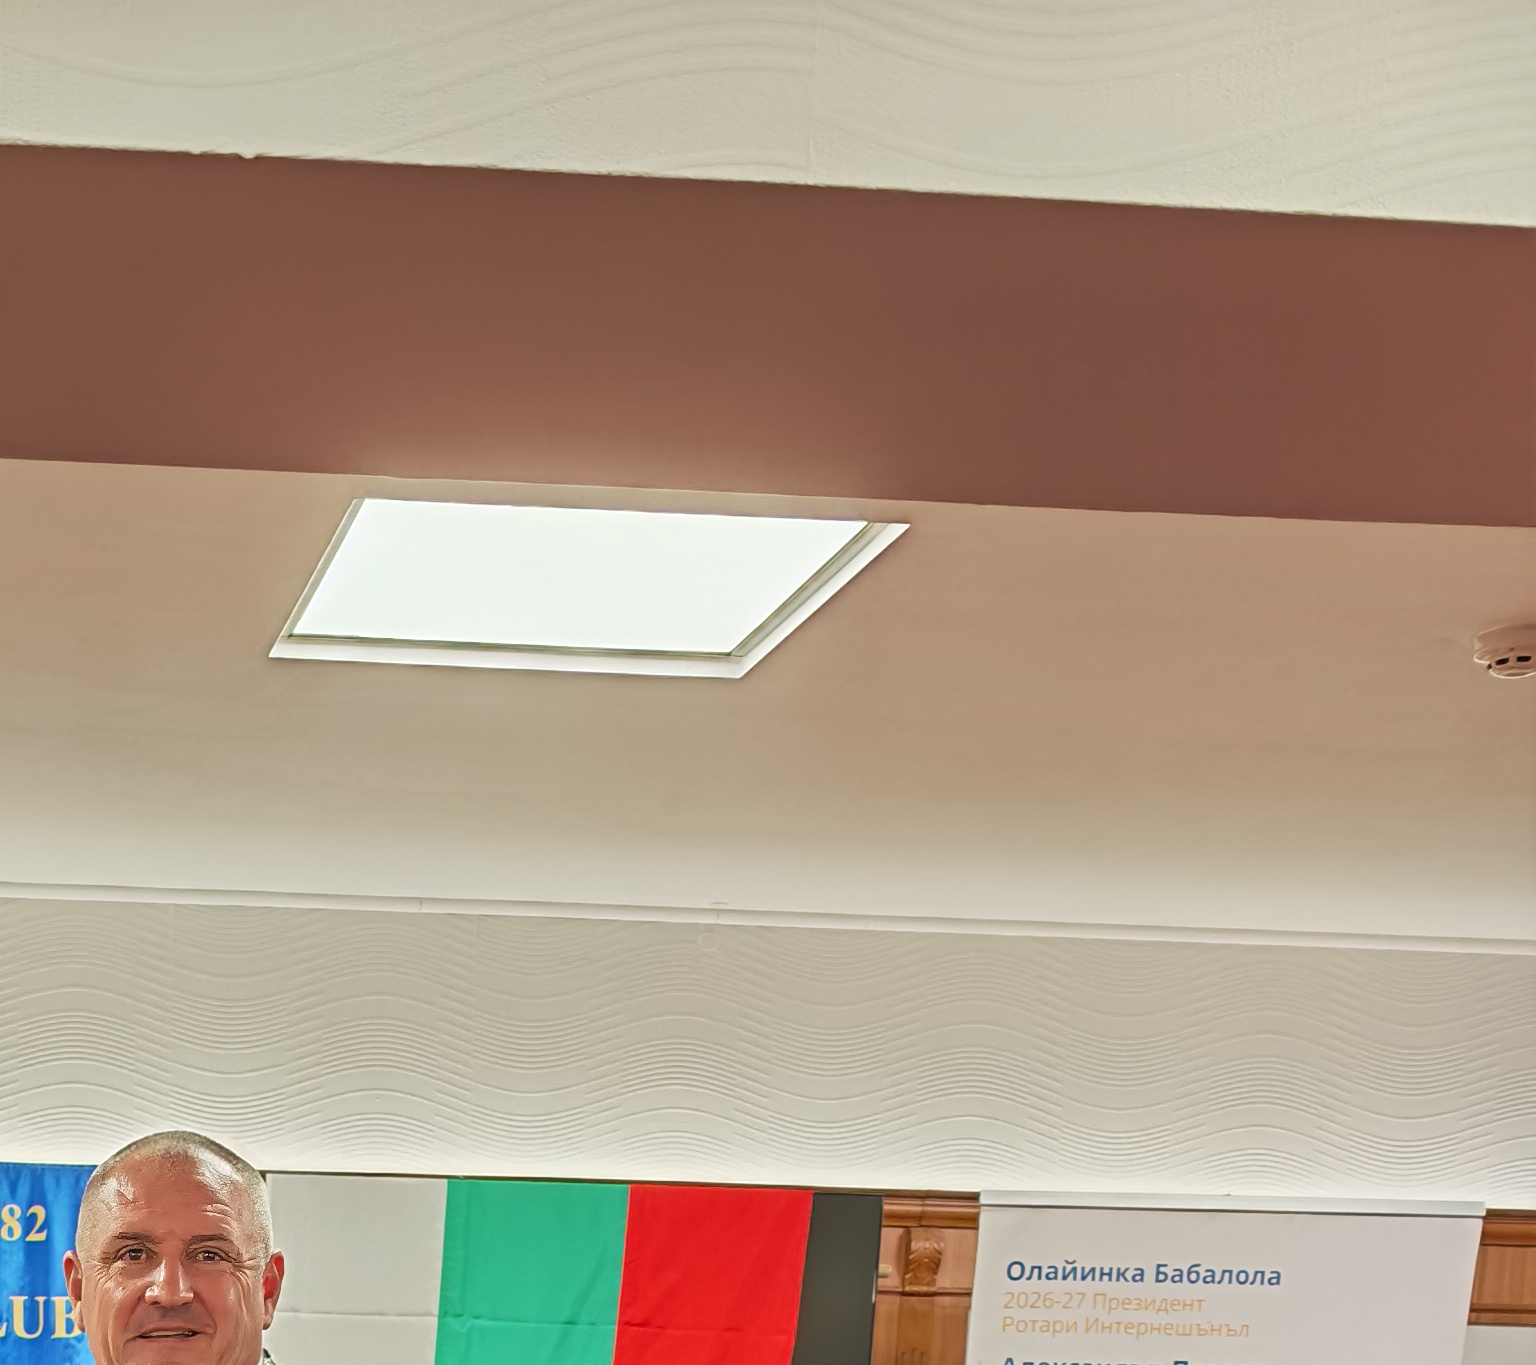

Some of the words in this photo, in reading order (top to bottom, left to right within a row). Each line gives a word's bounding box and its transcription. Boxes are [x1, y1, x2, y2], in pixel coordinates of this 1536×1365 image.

[1006, 1260, 1145, 1283] Олайинка
[1154, 1263, 1282, 1286] Бабалола
[1003, 1291, 1086, 1310] 2026-27
[1093, 1293, 1205, 1315] Президент
[1001, 1316, 1078, 1338] Ротари
[1084, 1317, 1250, 1340] Интернешънъл
